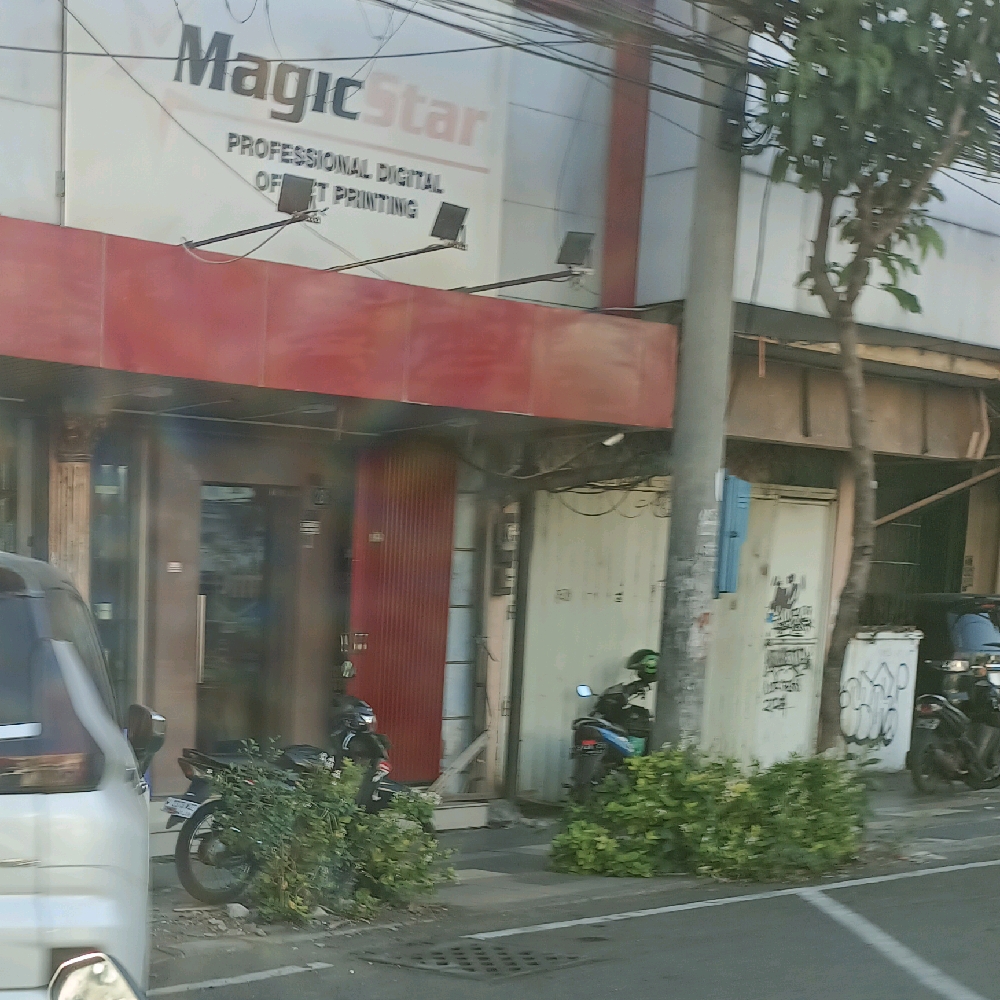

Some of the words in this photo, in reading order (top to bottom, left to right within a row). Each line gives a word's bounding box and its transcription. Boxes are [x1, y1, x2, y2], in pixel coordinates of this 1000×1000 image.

[227, 132, 373, 179] PROFESSIONAL
[376, 162, 445, 194] DIGITAL
[332, 185, 419, 219] PRINTING
